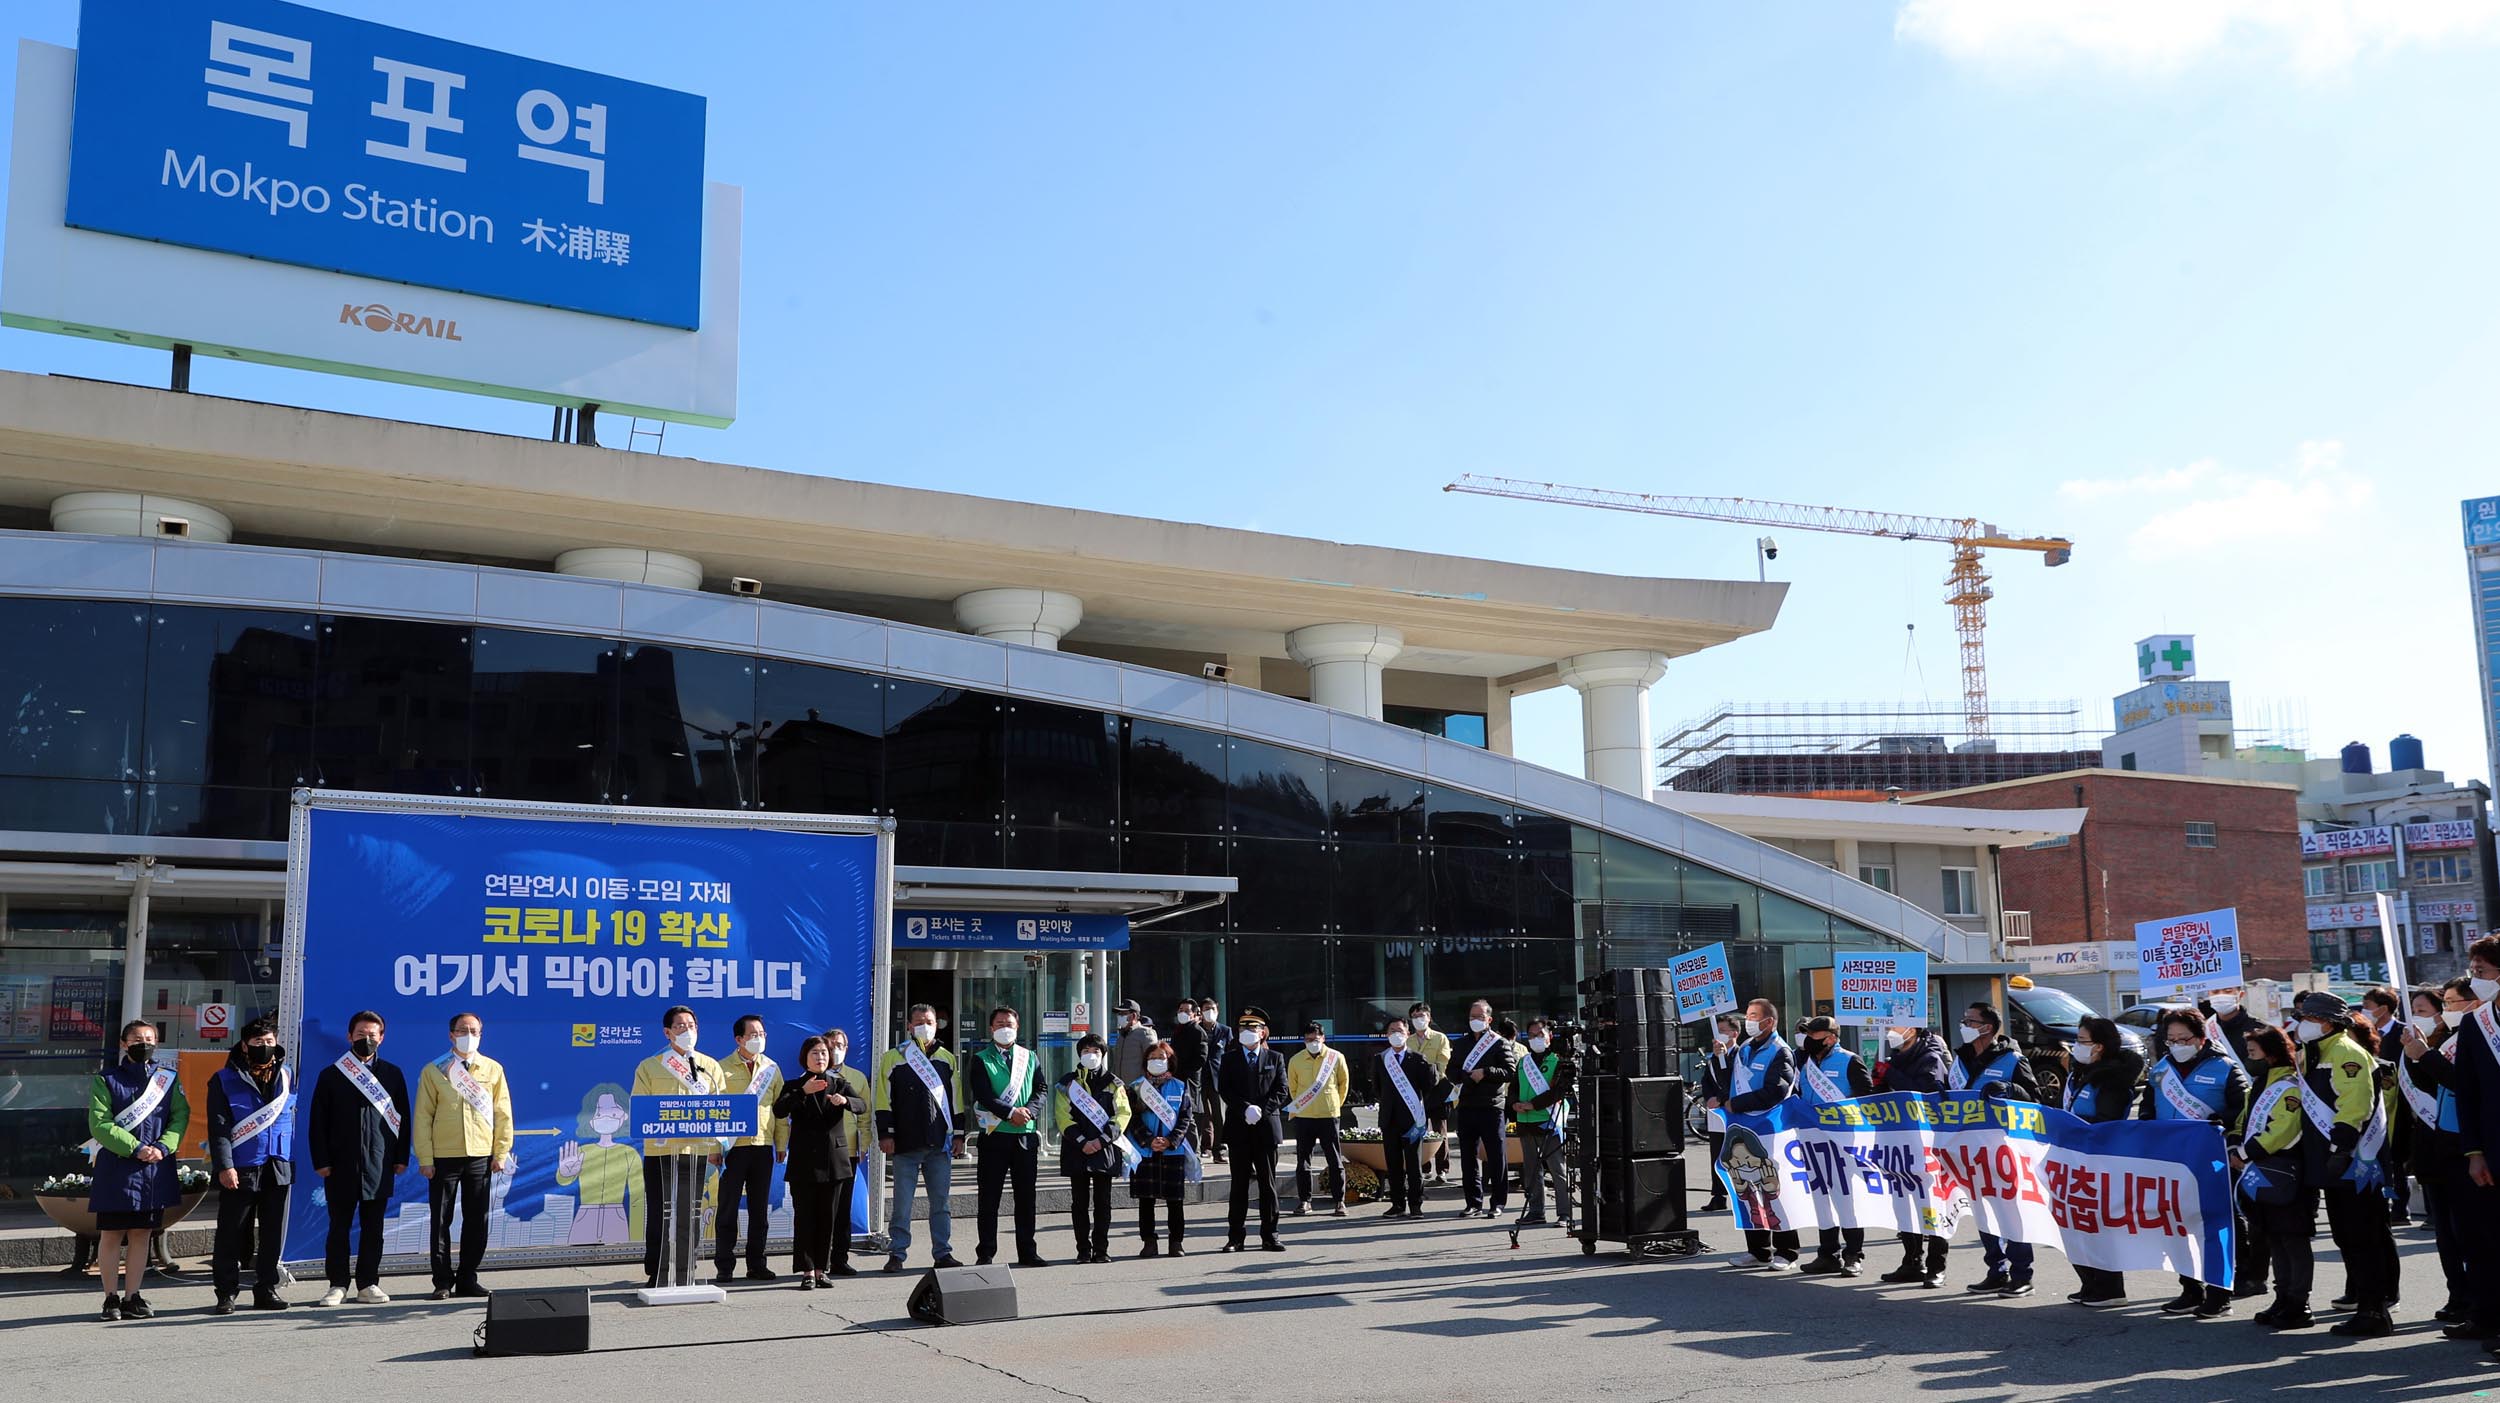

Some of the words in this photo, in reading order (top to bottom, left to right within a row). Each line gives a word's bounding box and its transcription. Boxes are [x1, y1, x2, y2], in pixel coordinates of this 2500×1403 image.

[204, 20, 609, 205] 목포역
[161, 148, 331, 216] Mokpo
[342, 183, 495, 245] Station
[520, 217, 631, 267] 木浦驛
[338, 303, 462, 342] KORAIL
[2326, 827, 2389, 850] 직업소개소
[2435, 821, 2473, 840] 직업소개소
[485, 873, 577, 899] 연말연시
[585, 877, 682, 902] 이동·모임
[689, 881, 732, 904] 자제
[481, 907, 601, 945] 코로나
[611, 910, 646, 946] 19
[658, 911, 732, 948] 확산
[931, 917, 965, 932] 표사는
[971, 918, 983, 933] 곳
[1039, 919, 1073, 934] 맞이방
[2161, 921, 2211, 942] 연말연시
[1384, 939, 1435, 958] UNIN
[2056, 951, 2080, 964] KTX
[1674, 955, 1708, 976] 사적모임은
[1841, 961, 1896, 974] 사적모임은
[2156, 959, 2223, 980] 자제합시다!
[394, 954, 529, 997] 여기서
[545, 956, 673, 999] 막아야
[686, 957, 807, 1001] 합니다
[1677, 973, 1711, 992] 8인까지만
[1710, 967, 1725, 985] 허용
[1841, 979, 1892, 993] 8인까지만
[1895, 978, 1918, 992] 허용
[1681, 992, 1705, 1009] 됩니다.
[1841, 996, 1878, 1010] 됩니다.
[599, 1026, 643, 1038] 전라남도
[659, 1100, 686, 1108] 연말연시
[658, 1109, 693, 1121] 코로나
[695, 1109, 706, 1120] 19
[708, 1109, 731, 1120] 확산
[642, 1122, 676, 1134] 여기서
[678, 1121, 712, 1133] 막아야
[714, 1121, 748, 1133] 합니다
[2045, 1159, 2188, 1238] 멈춥니다!
